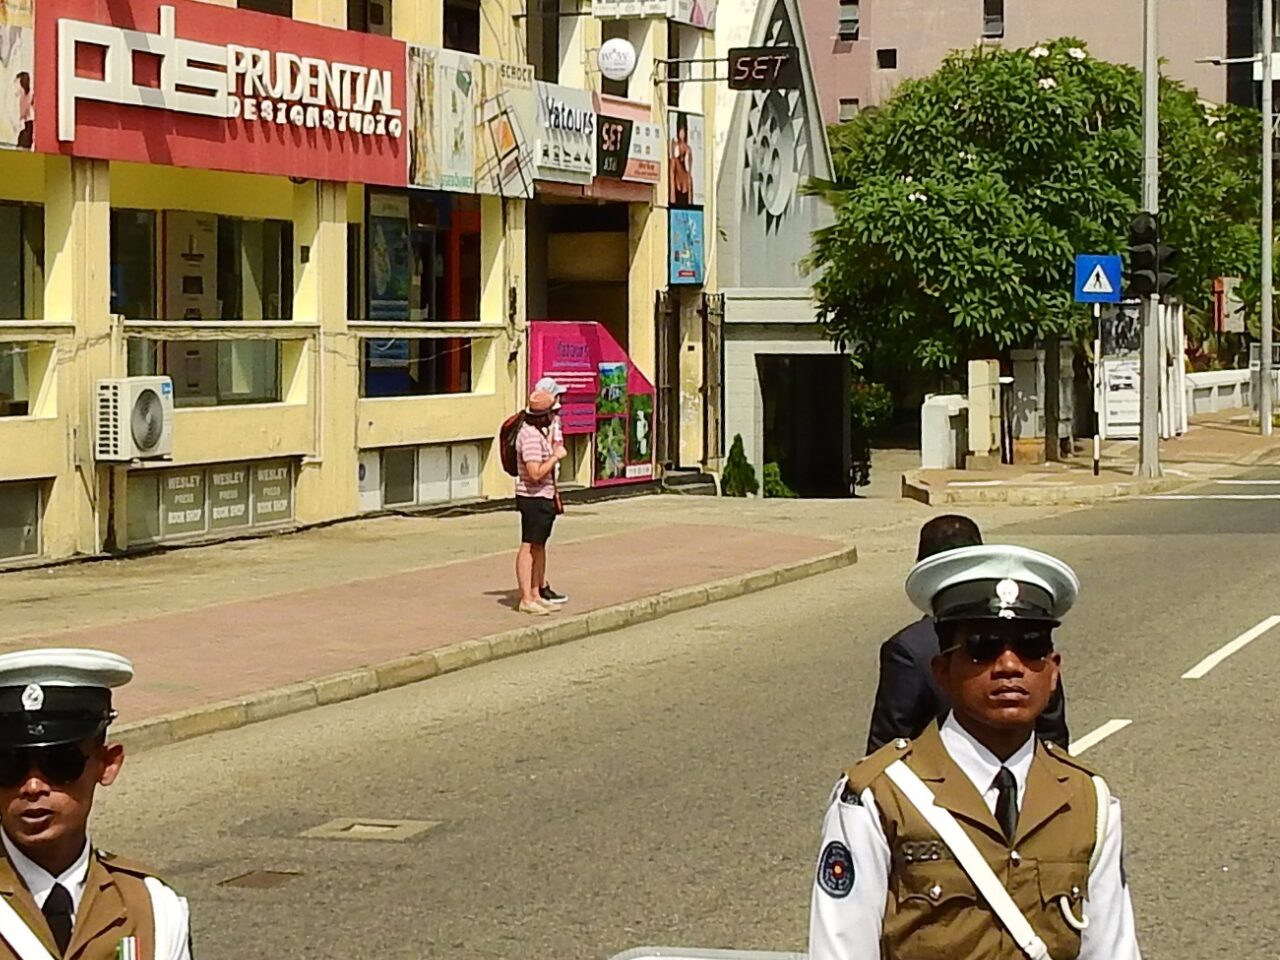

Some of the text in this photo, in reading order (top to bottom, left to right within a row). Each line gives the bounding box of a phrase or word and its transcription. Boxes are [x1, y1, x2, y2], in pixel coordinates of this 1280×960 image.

[734, 54, 788, 80] SET
[227, 44, 401, 116] PRUDENTIAL
[546, 96, 593, 135] Yatours
[168, 475, 200, 489] WESLEY
[212, 472, 244, 486] WESLEY
[257, 468, 287, 481] WESLEY
